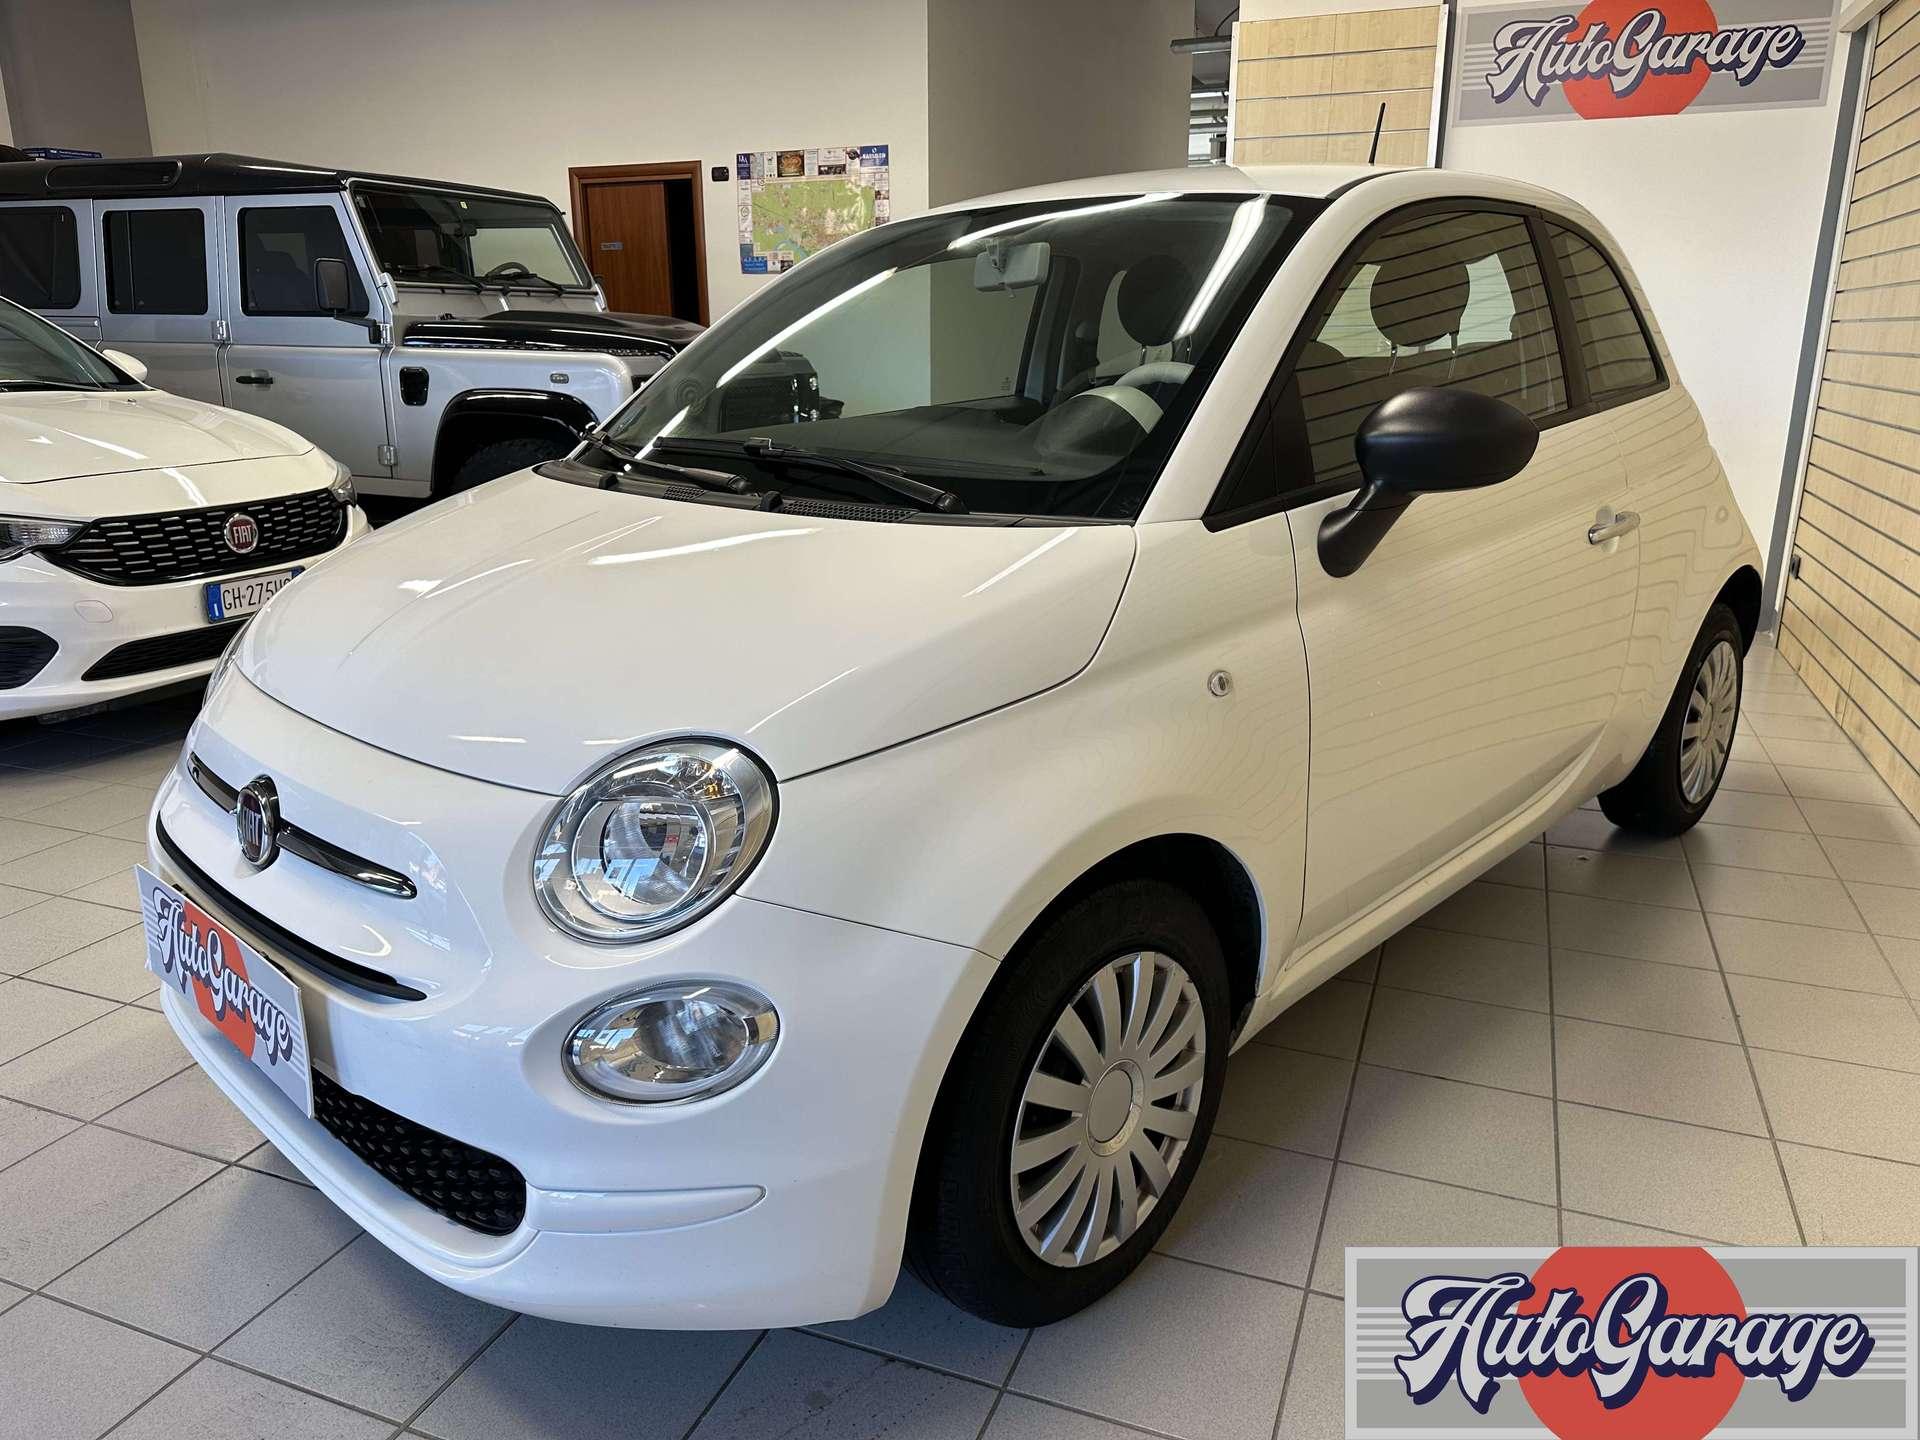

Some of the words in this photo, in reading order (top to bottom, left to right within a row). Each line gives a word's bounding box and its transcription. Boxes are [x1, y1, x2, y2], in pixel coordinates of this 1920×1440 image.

[1485, 8, 1806, 107] AutoGarage
[232, 524, 253, 544] FIAT
[152, 886, 293, 1066] AutoGarage
